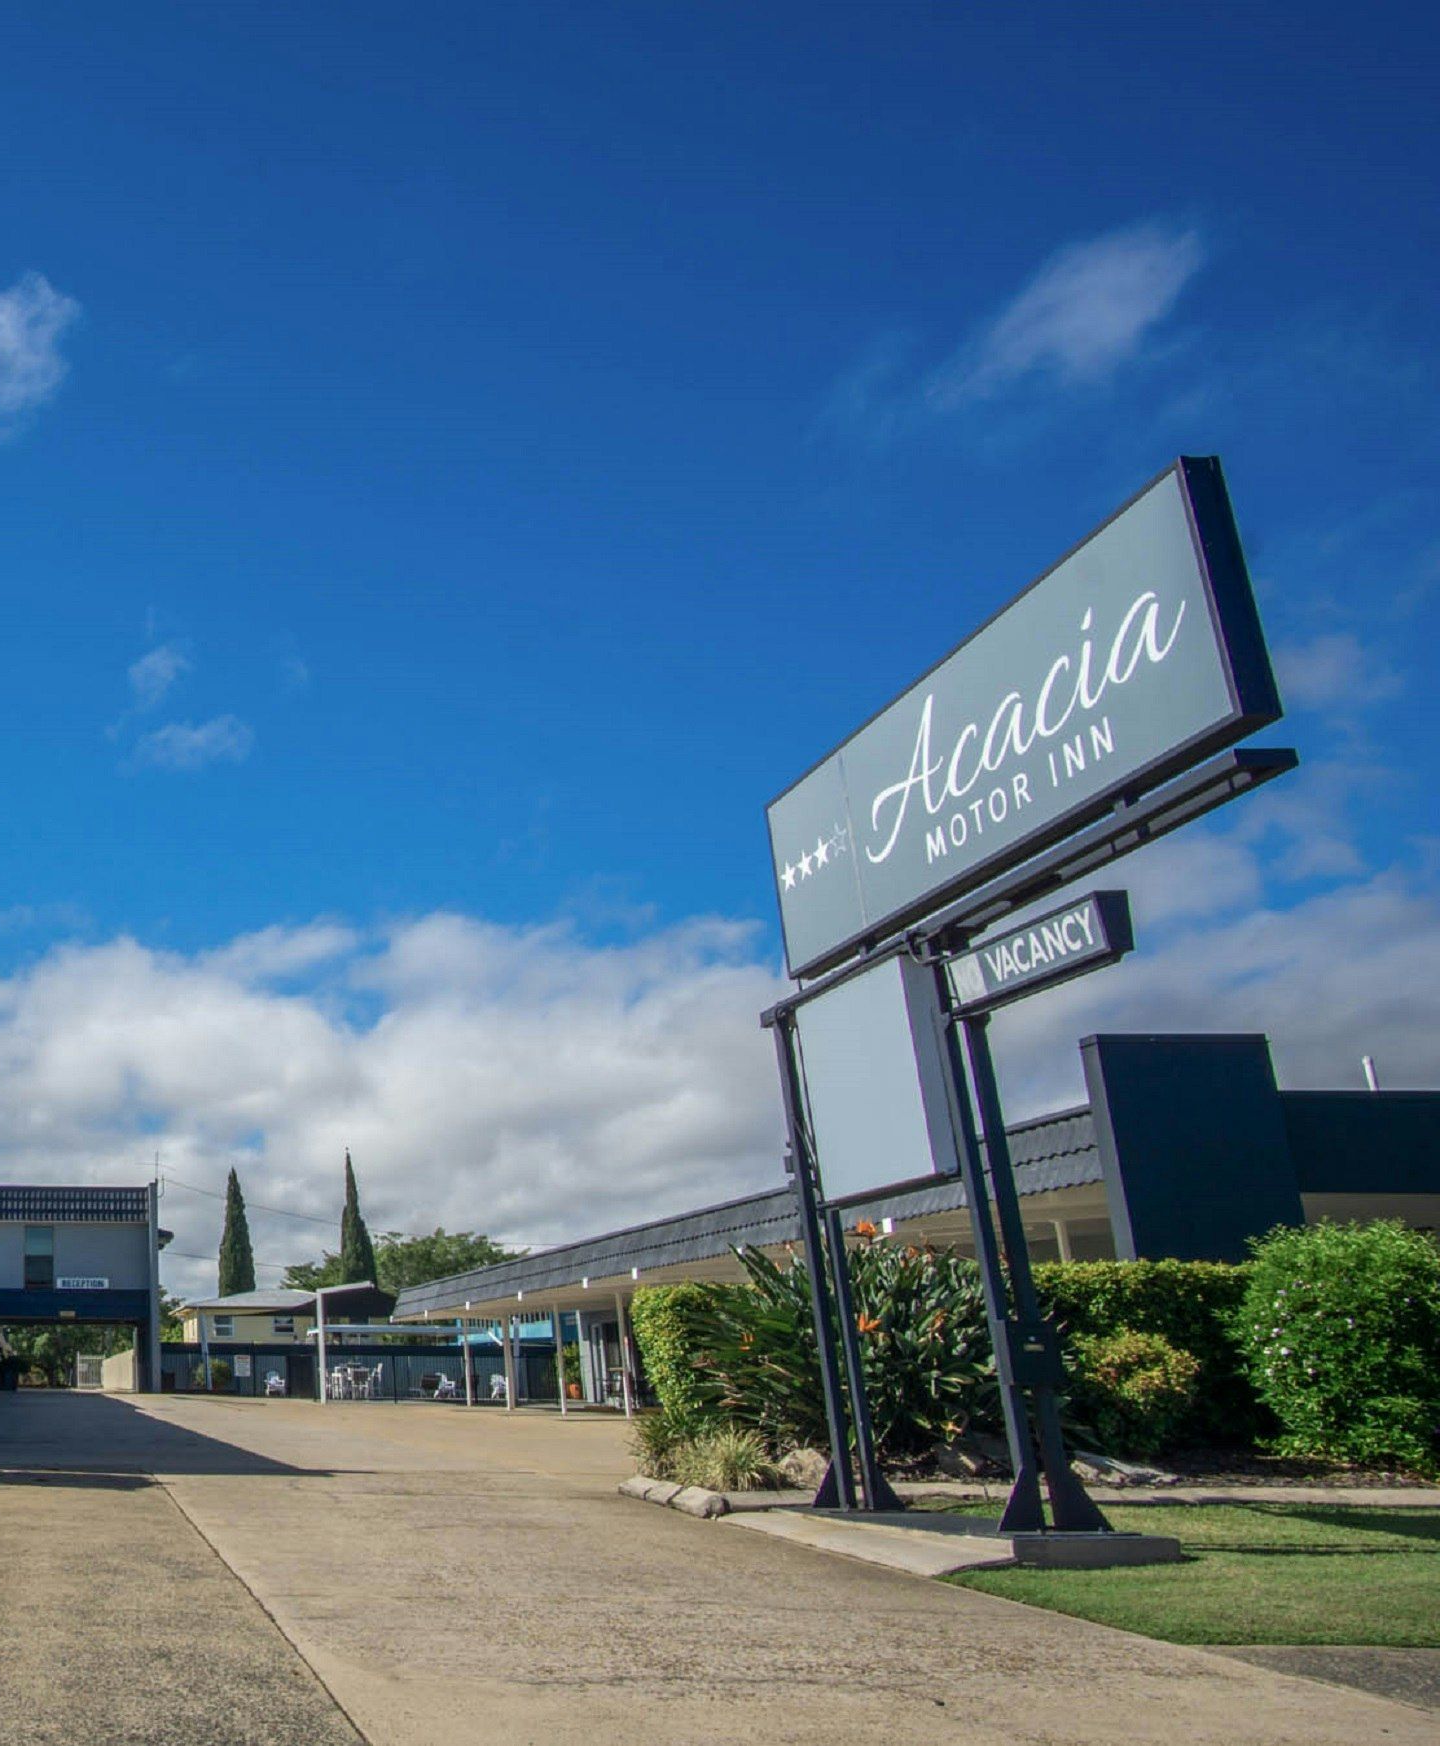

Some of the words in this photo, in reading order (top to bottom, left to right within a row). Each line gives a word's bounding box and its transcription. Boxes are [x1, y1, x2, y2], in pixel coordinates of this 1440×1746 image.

[866, 591, 1186, 864] Acacia
[925, 773, 1032, 864] MOTOR
[1048, 715, 1116, 788] INN
[985, 908, 1096, 982] VACANCY
[61, 1279, 105, 1288] RECEPTION
